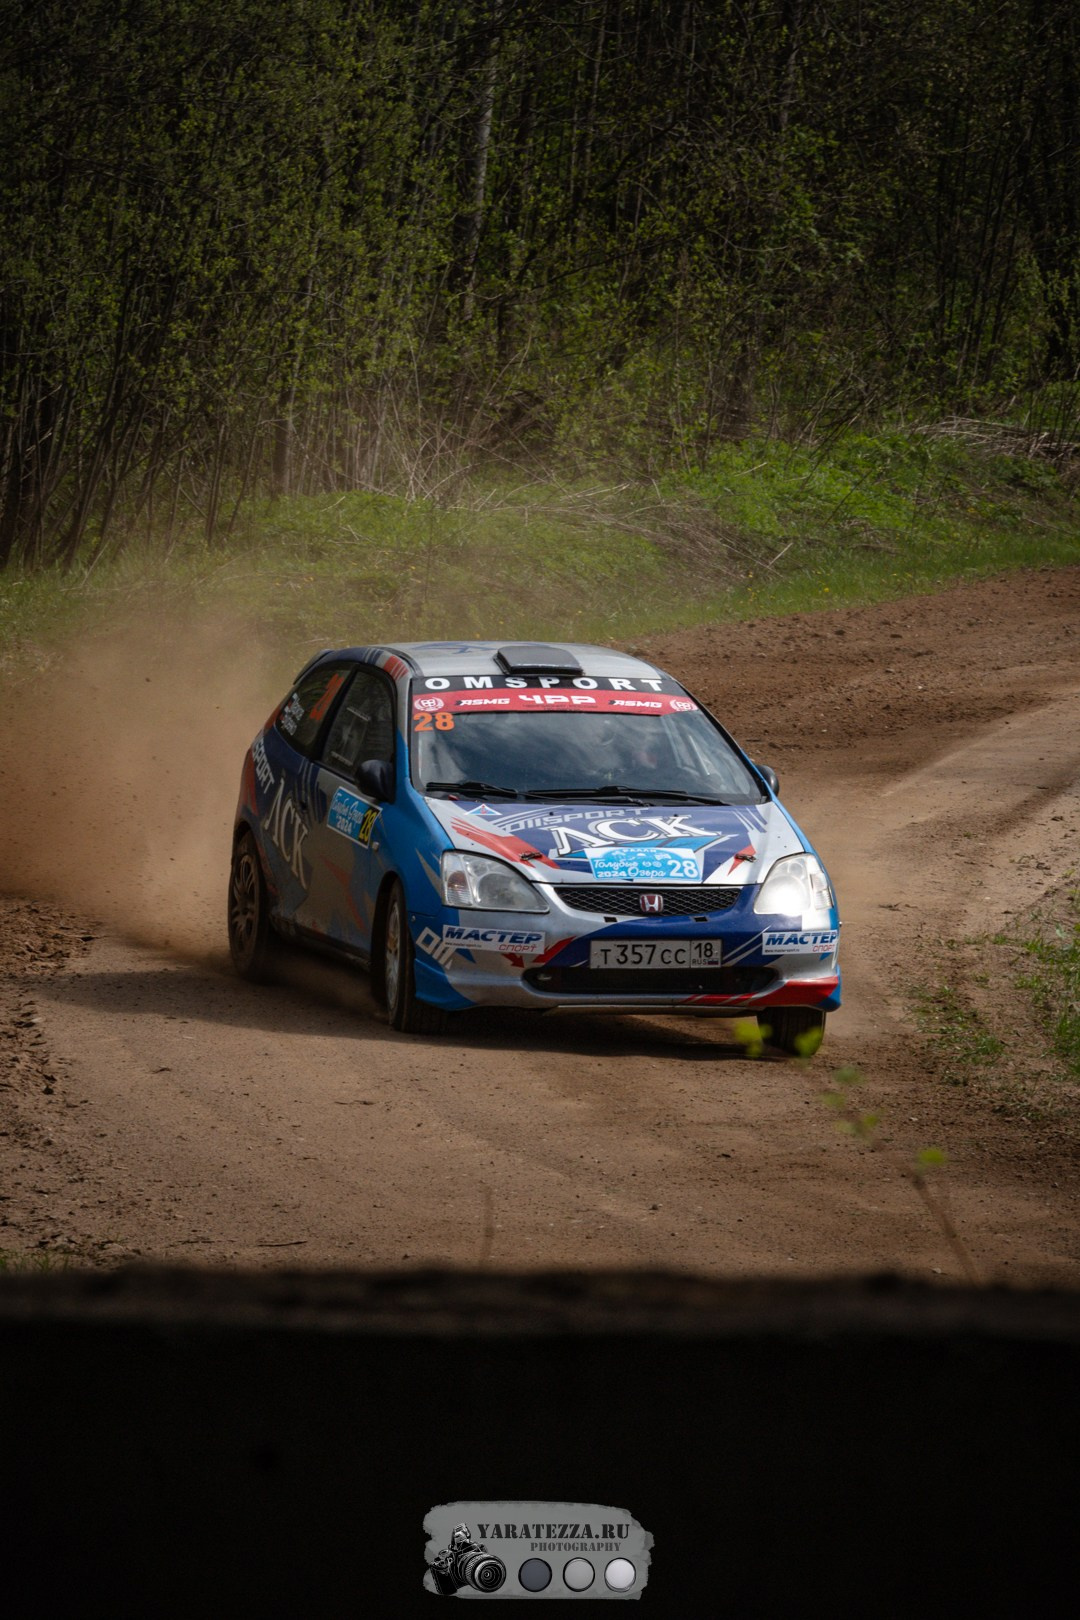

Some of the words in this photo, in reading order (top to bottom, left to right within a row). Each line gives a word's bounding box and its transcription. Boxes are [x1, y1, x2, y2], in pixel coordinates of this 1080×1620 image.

[424, 676, 662, 692] OMSPORT
[413, 712, 455, 732] 28
[359, 809, 378, 842] 28
[547, 814, 720, 857] ЛСК
[667, 860, 698, 878] 28
[445, 927, 542, 945] МАСТЕР
[765, 931, 837, 946] МАСТЕР
[498, 943, 537, 952] СПОРТ
[694, 943, 713, 958] 18
